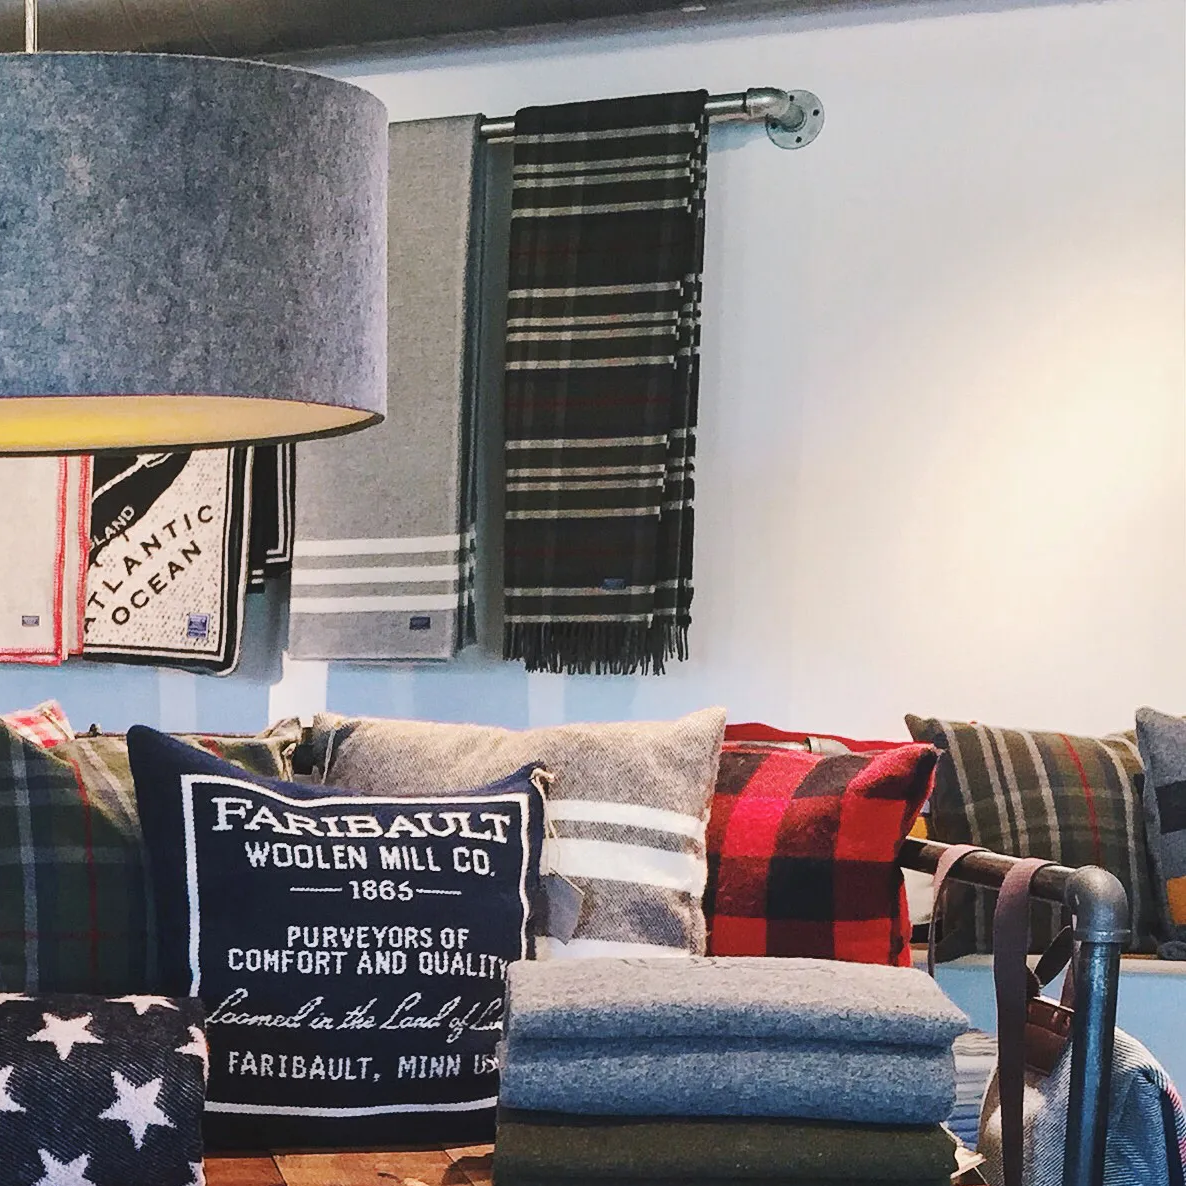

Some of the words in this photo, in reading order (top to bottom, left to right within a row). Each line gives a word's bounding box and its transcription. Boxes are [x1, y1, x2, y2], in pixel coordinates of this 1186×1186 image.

[111, 540, 202, 625] OCEAN
[210, 797, 512, 844] FARIBAULT
[244, 842, 367, 870] WOOLEN
[380, 845, 441, 872] MILL
[453, 847, 495, 877] CO.
[349, 880, 414, 902] 1865
[287, 925, 432, 949] PURVEYORS
[440, 927, 469, 949] OF
[227, 949, 343, 974] COMFORT
[357, 950, 407, 975] AND
[419, 952, 508, 980] QUALITY
[308, 1011, 335, 1030] in
[336, 997, 378, 1031] the
[379, 991, 463, 1030] Land
[445, 1001, 481, 1044] of
[228, 1050, 380, 1083] FARIBAULT,
[398, 1054, 461, 1079] MINN
